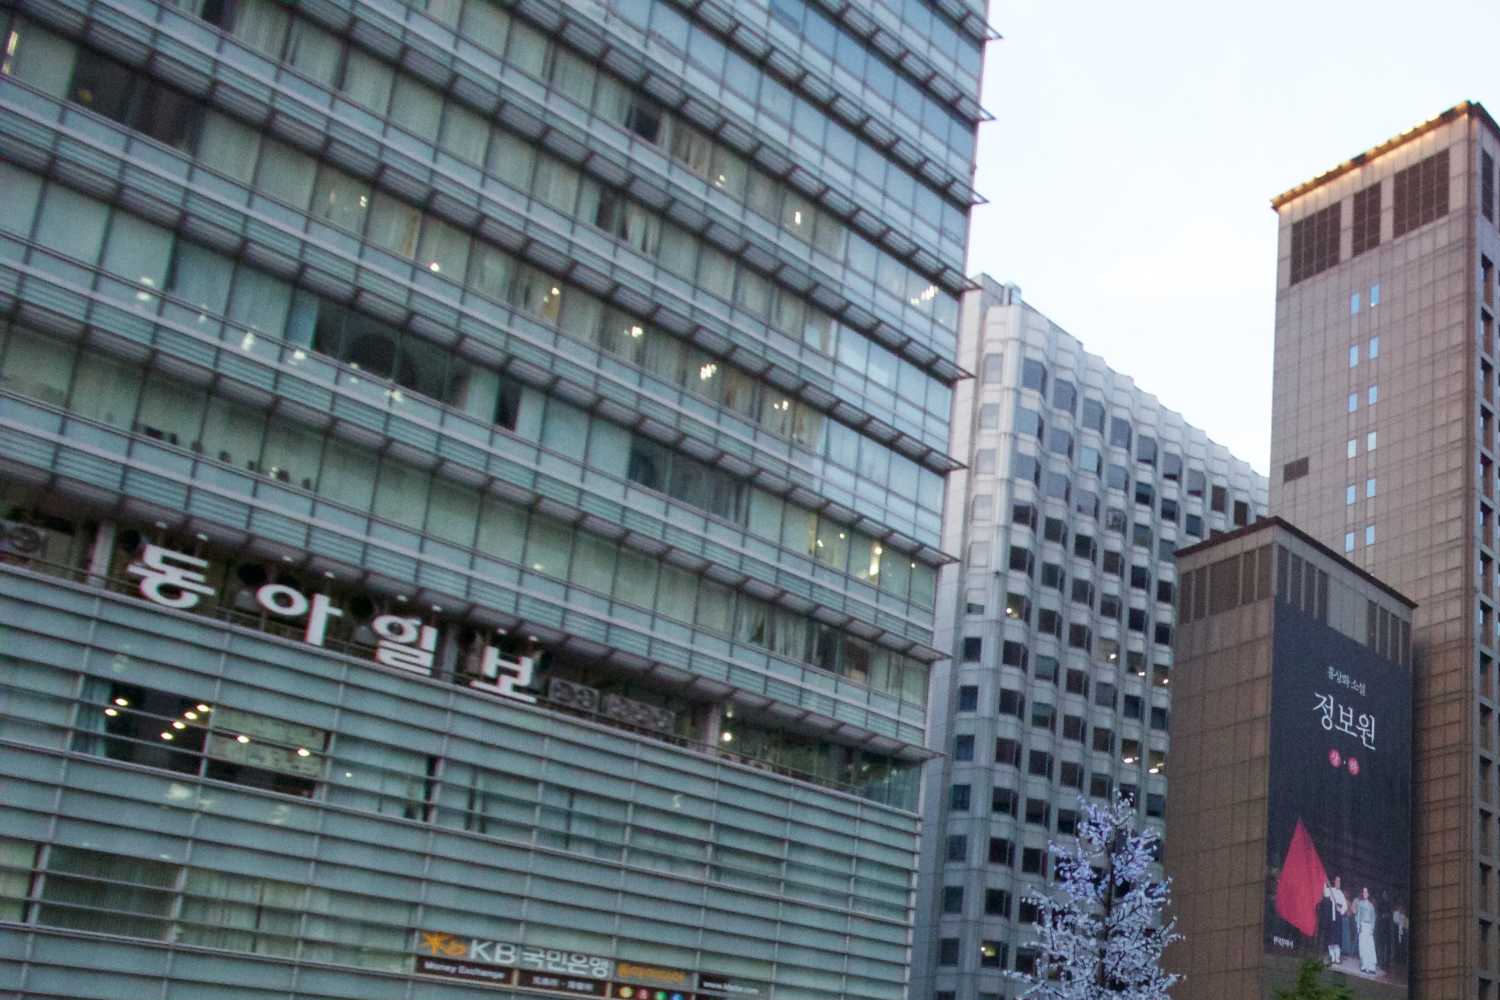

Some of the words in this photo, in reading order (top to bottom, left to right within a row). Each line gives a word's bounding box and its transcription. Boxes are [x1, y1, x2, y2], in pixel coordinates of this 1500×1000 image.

[127, 543, 537, 704] 동아일보
[1312, 692, 1376, 751] 정보원
[470, 938, 516, 965] KB
[522, 946, 610, 979] 국민은행
